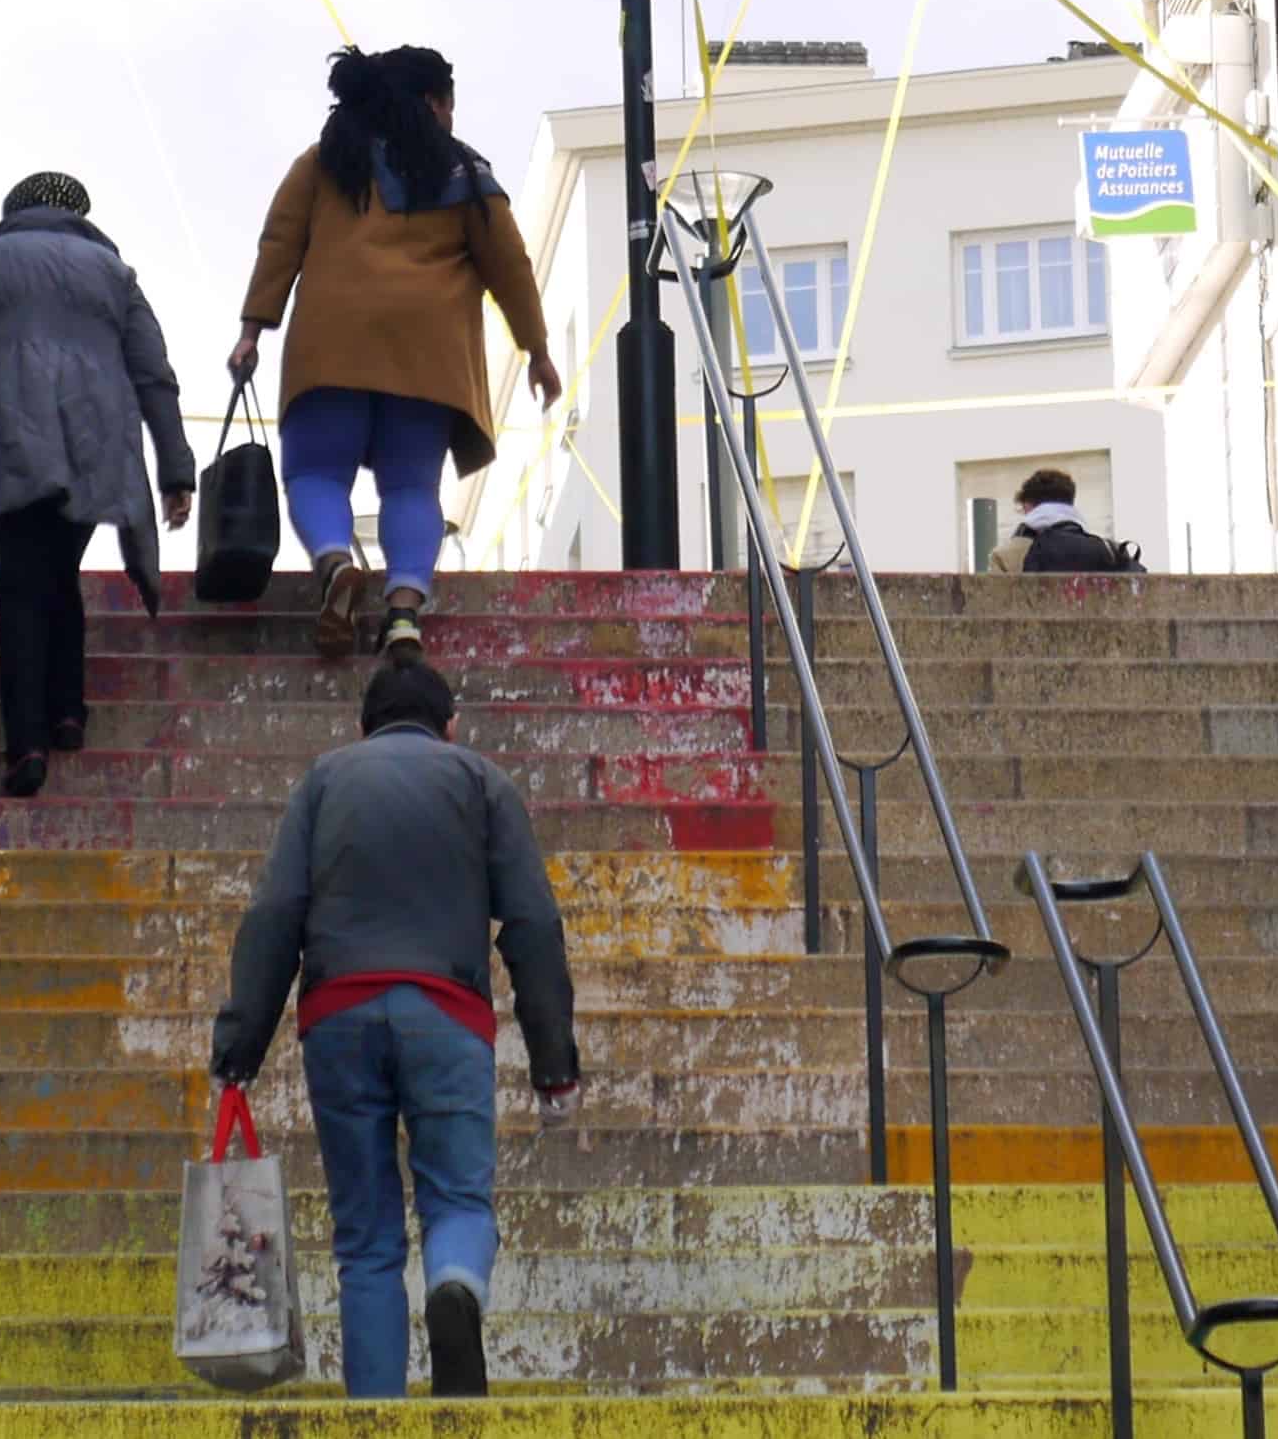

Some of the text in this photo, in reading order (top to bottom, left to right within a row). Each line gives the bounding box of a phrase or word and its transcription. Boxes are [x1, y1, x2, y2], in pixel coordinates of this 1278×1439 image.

[1095, 142, 1164, 160] Mutuelle
[1097, 162, 1177, 178] de Poitiers
[1098, 181, 1184, 196] Assurances
